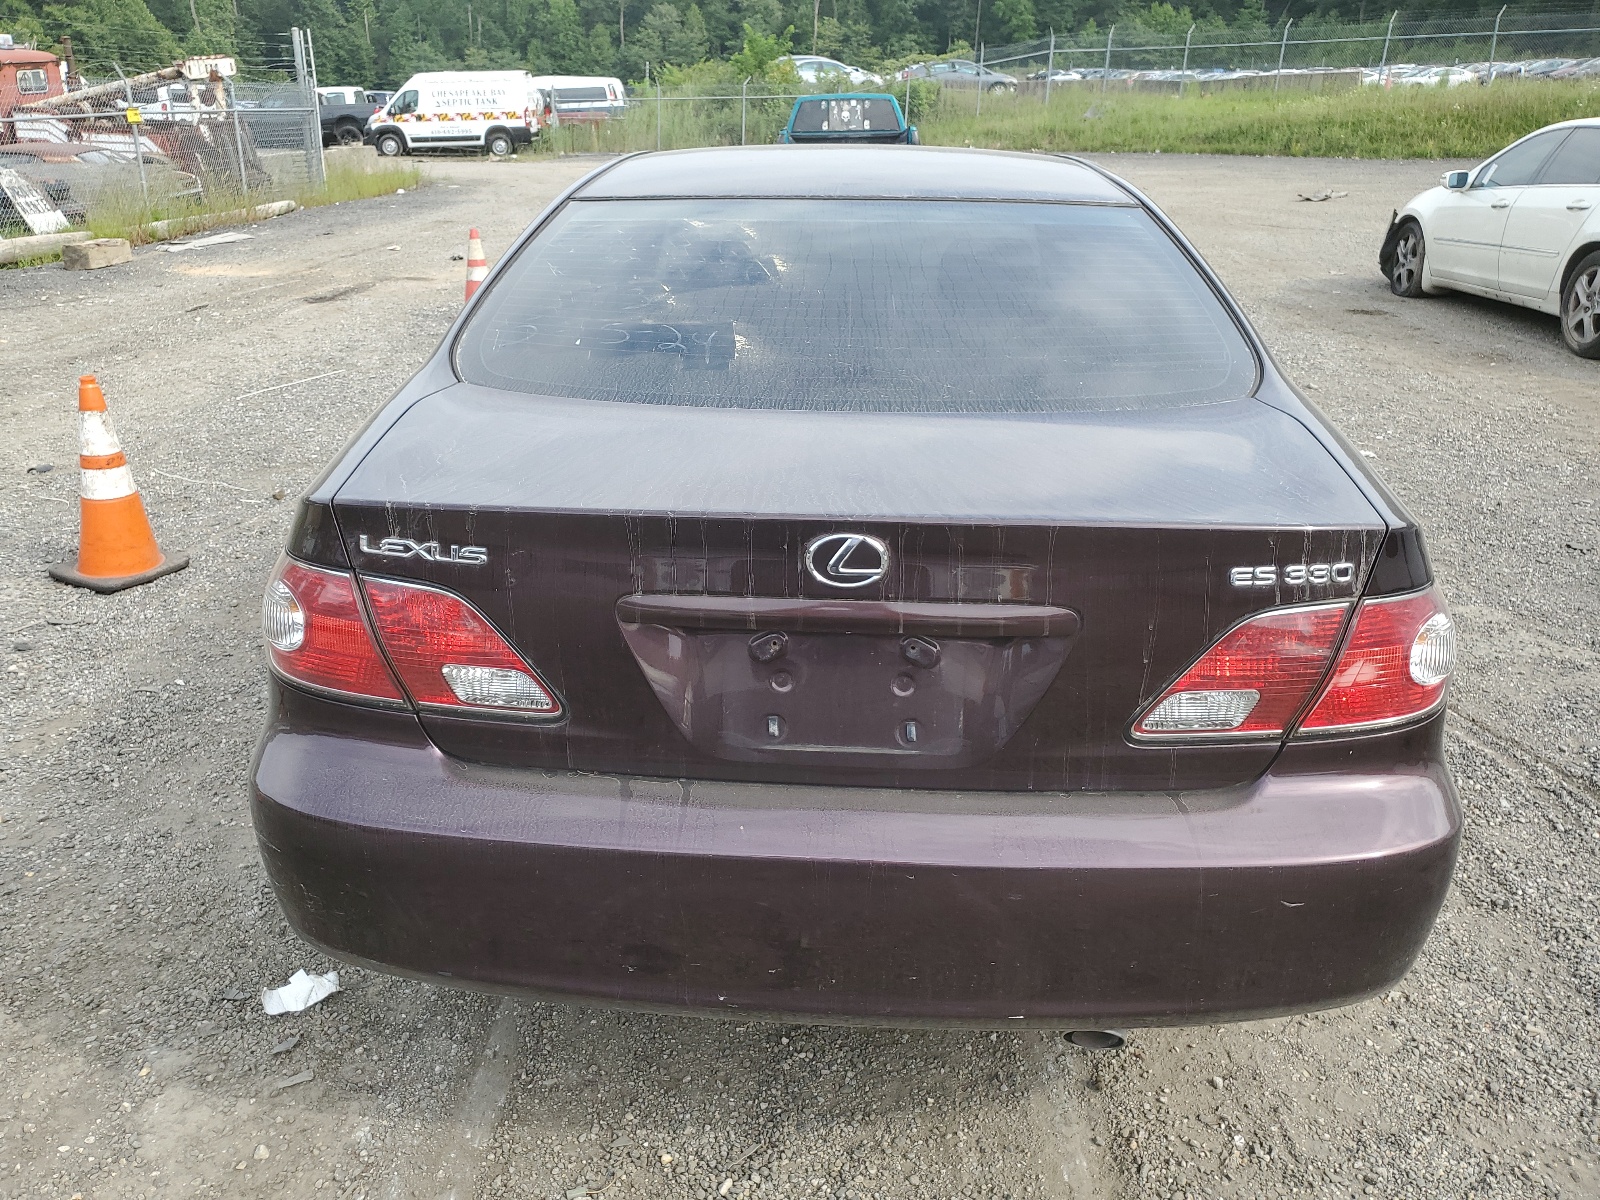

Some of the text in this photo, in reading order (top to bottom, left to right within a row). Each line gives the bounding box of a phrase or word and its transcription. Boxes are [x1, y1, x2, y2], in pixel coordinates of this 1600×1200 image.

[431, 89, 506, 98] CHESAPEAKE BAY
[441, 97, 498, 106] SEPTIC TANK
[359, 533, 488, 566] LEXUS
[1229, 562, 1355, 587] ES 330
